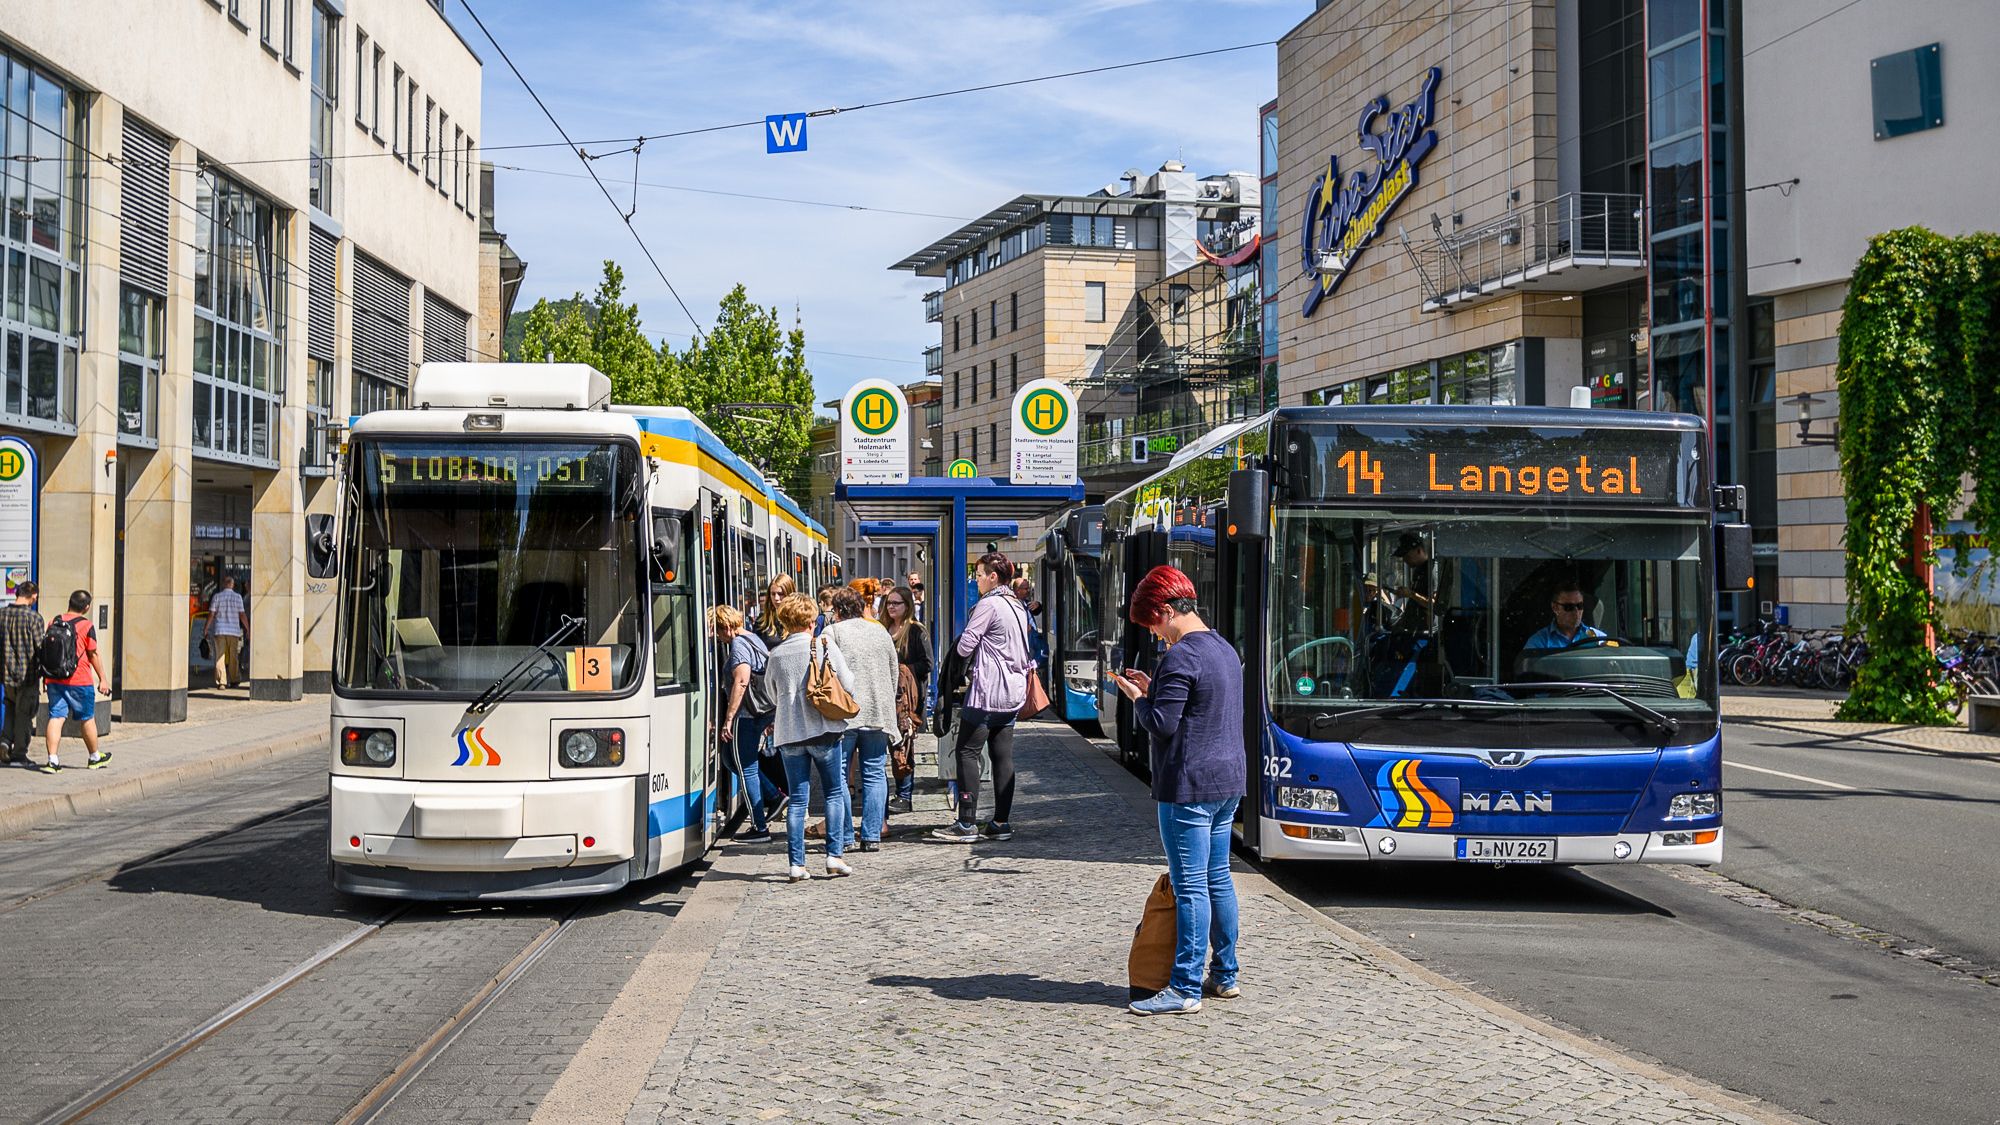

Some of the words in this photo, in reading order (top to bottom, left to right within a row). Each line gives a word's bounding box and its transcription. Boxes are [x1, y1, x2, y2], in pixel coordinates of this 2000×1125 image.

[769, 119, 804, 147] W
[1343, 158, 1410, 258] Filmpalast
[865, 398, 885, 425] H
[1035, 398, 1055, 425] H
[380, 453, 396, 484] 5
[1337, 450, 1384, 495] 14
[1429, 453, 1642, 496] Langetal
[587, 658, 600, 677] 3
[1263, 755, 1293, 779] 262
[1462, 792, 1553, 812] MAN
[1472, 841, 1484, 857] J
[1493, 842, 1515, 858] NV
[1517, 842, 1548, 858] 262
